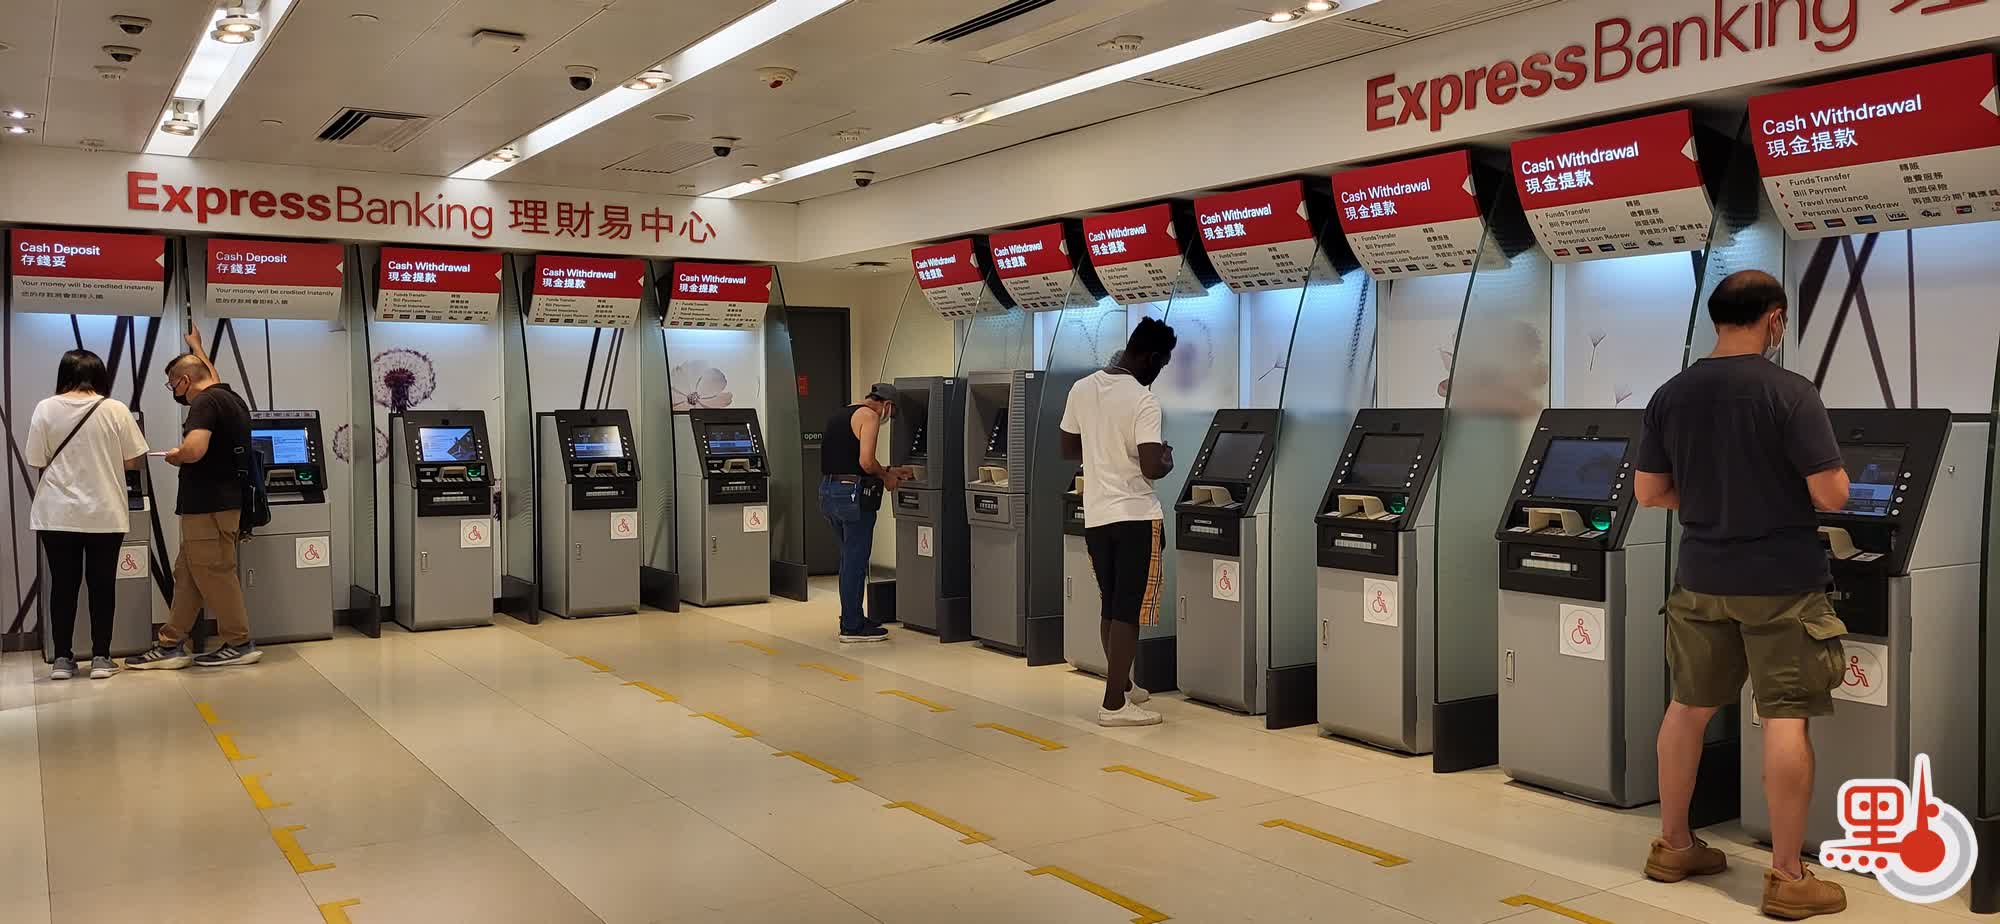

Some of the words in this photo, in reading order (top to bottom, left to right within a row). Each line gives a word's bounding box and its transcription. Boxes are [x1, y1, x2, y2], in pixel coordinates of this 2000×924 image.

[1365, 0, 1860, 133] ExpressBanking
[1762, 115, 1807, 136] Cash
[1810, 94, 1922, 128] Withdrawal
[1766, 127, 1858, 159] 現金提款
[1521, 156, 1555, 175] Cash
[1556, 140, 1639, 169] Withdrawal
[1525, 168, 1594, 195] 現金提款
[1341, 190, 1367, 204] Cash
[1367, 178, 1431, 199] Withdrawal
[1793, 188, 1807, 197] Bill
[1809, 185, 1847, 196] Payment
[126, 170, 494, 240] ExpressBanking
[507, 198, 718, 245] 理財易中心
[1799, 199, 1824, 208] Travel
[1825, 193, 1869, 204] Insurance
[1200, 212, 1221, 225] Cash
[1222, 203, 1272, 221] Withdrawal
[1344, 200, 1398, 221] 現金提款
[1802, 207, 1839, 217] Personal
[1841, 205, 1863, 214] Loan
[1865, 201, 1899, 210] Redraw
[1203, 222, 1247, 240] 現金提款
[1549, 220, 1560, 228] Bill
[1560, 218, 1589, 227] Payment
[1088, 231, 1106, 242] Cash
[1106, 223, 1147, 239] Withdrawal
[20, 241, 51, 253] Cash
[53, 243, 101, 256] Deposit
[994, 246, 1009, 257] Cash
[1008, 239, 1043, 255] Withdrawal
[215, 251, 243, 261] Cash
[246, 252, 288, 264] Deposit
[915, 260, 928, 270] Cash
[388, 260, 413, 270] Cash
[414, 261, 471, 273] Withdrawal
[542, 267, 565, 277] Cash
[566, 268, 617, 279] Withdrawal
[21, 279, 38, 287] Your
[388, 271, 437, 283] 現金提款
[542, 278, 586, 289] 現金提款
[679, 273, 700, 282] Cash
[701, 274, 747, 284] Withdrawal
